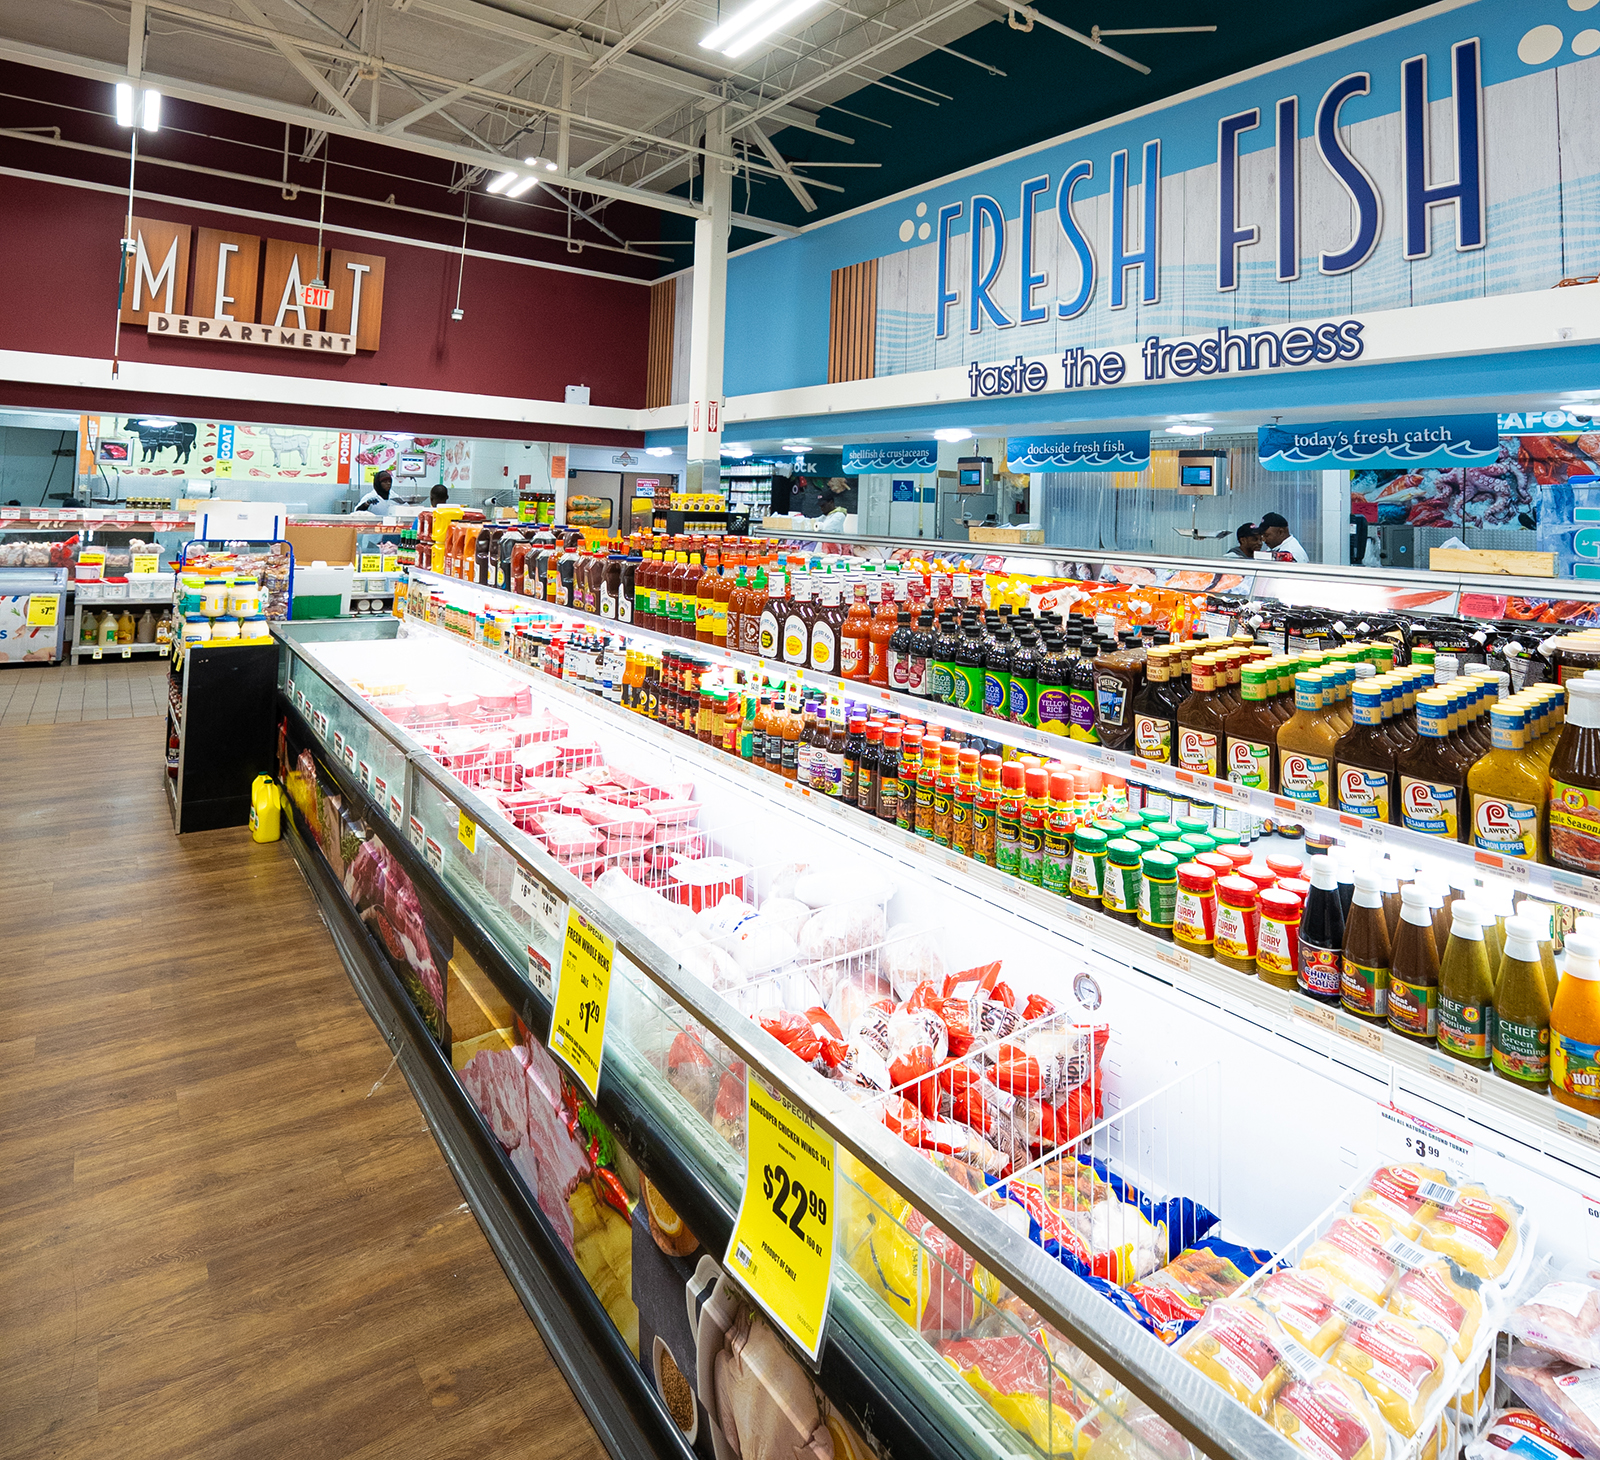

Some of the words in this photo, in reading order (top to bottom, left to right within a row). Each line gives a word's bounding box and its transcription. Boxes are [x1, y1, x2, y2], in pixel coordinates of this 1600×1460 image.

[934, 137, 1162, 340] FRESH
[1216, 35, 1487, 292] FISH
[132, 229, 371, 336] MEAT
[304, 286, 330, 308] EXIT
[157, 316, 352, 352] DEPARTMENT
[968, 355, 1049, 398] taste
[1062, 345, 1127, 388] the
[1143, 318, 1366, 381] freshness
[221, 427, 233, 459] GOAT
[1294, 431, 1349, 450] today's
[1353, 429, 1398, 444] fresh
[1404, 426, 1452, 443] catch
[340, 433, 350, 465] PORK
[849, 449, 878, 459] shellfish
[878, 449, 886, 458] &
[886, 449, 930, 459] crustaceans
[1027, 442, 1070, 454] dockside
[1073, 441, 1100, 453] fresh
[1103, 439, 1125, 452] fish
[1041, 699, 1069, 707] YELLOW
[1287, 778, 1313, 786] LAWRY'S
[1365, 778, 1386, 786] MARINADE
[1283, 787, 1296, 796] HERB
[1300, 790, 1318, 798] GARLIC
[1344, 793, 1372, 801] LAWRY'S
[1432, 791, 1454, 799] MARINADE
[1341, 803, 1359, 813] SESAME
[1359, 806, 1377, 814] GINGER
[1409, 806, 1440, 814] LAWRY'S
[1509, 810, 1534, 819] MARINADE
[1405, 817, 1426, 828] SESAME
[1426, 820, 1445, 829] GINGER
[1483, 826, 1517, 835] LAWRY'S
[1477, 837, 1499, 849] LEMON
[1499, 840, 1525, 850] PEPPER
[1510, 865, 1526, 875] 4.89
[1178, 904, 1196, 918] CURRY
[1218, 919, 1238, 933] CURRY
[587, 923, 605, 945] SPECIAL
[1260, 932, 1281, 947] CURRY
[567, 926, 582, 947] FRESH
[582, 938, 598, 961] WHOLE
[597, 952, 610, 972] HENS
[581, 974, 589, 988] SALE
[1304, 966, 1341, 981] CHINES
[1308, 977, 1339, 989] SAUCE
[1391, 992, 1408, 1005] Meat
[1368, 1031, 1381, 1041] 2.99
[1499, 1019, 1538, 1039] CHIEF
[1501, 1033, 1534, 1049] Green
[1501, 1041, 1546, 1057] Seasoning
[1463, 1070, 1479, 1084] 3.29
[1572, 1073, 1597, 1086] HOT
[781, 1097, 815, 1130] SPECIAL
[750, 1097, 778, 1128] AGROSUPER
[778, 1120, 800, 1146] CHICKEN
[800, 1138, 819, 1162] WINGS
[820, 1154, 827, 1168] 10
[1397, 1118, 1405, 1126] ALL
[1405, 1122, 1428, 1137] NATURAL
[1428, 1131, 1448, 1146] GROUND
[1448, 1142, 1469, 1155] TURKEY
[1392, 1167, 1421, 1184] Tyson
[1380, 1178, 1405, 1195] PREMIUM
[1394, 1190, 1409, 1201] HEN
[1463, 1198, 1493, 1211] Tyson
[1472, 1222, 1488, 1232] HEN
[806, 1235, 816, 1250] 160
[815, 1244, 823, 1257] OZ
[761, 1240, 780, 1266] PRODUCT
[784, 1264, 797, 1282] CHILE
[1240, 1340, 1257, 1357] HEN
[1360, 1333, 1394, 1356] CORNISH
[1393, 1351, 1412, 1367] HEN
[1226, 1356, 1236, 1366] NO
[1236, 1364, 1255, 1383] ADDED
[1381, 1369, 1392, 1379] NO
[1392, 1377, 1412, 1394] ADDED
[1321, 1419, 1339, 1438] HEN
[1508, 1416, 1537, 1430] Whole
[1306, 1435, 1317, 1447] NO
